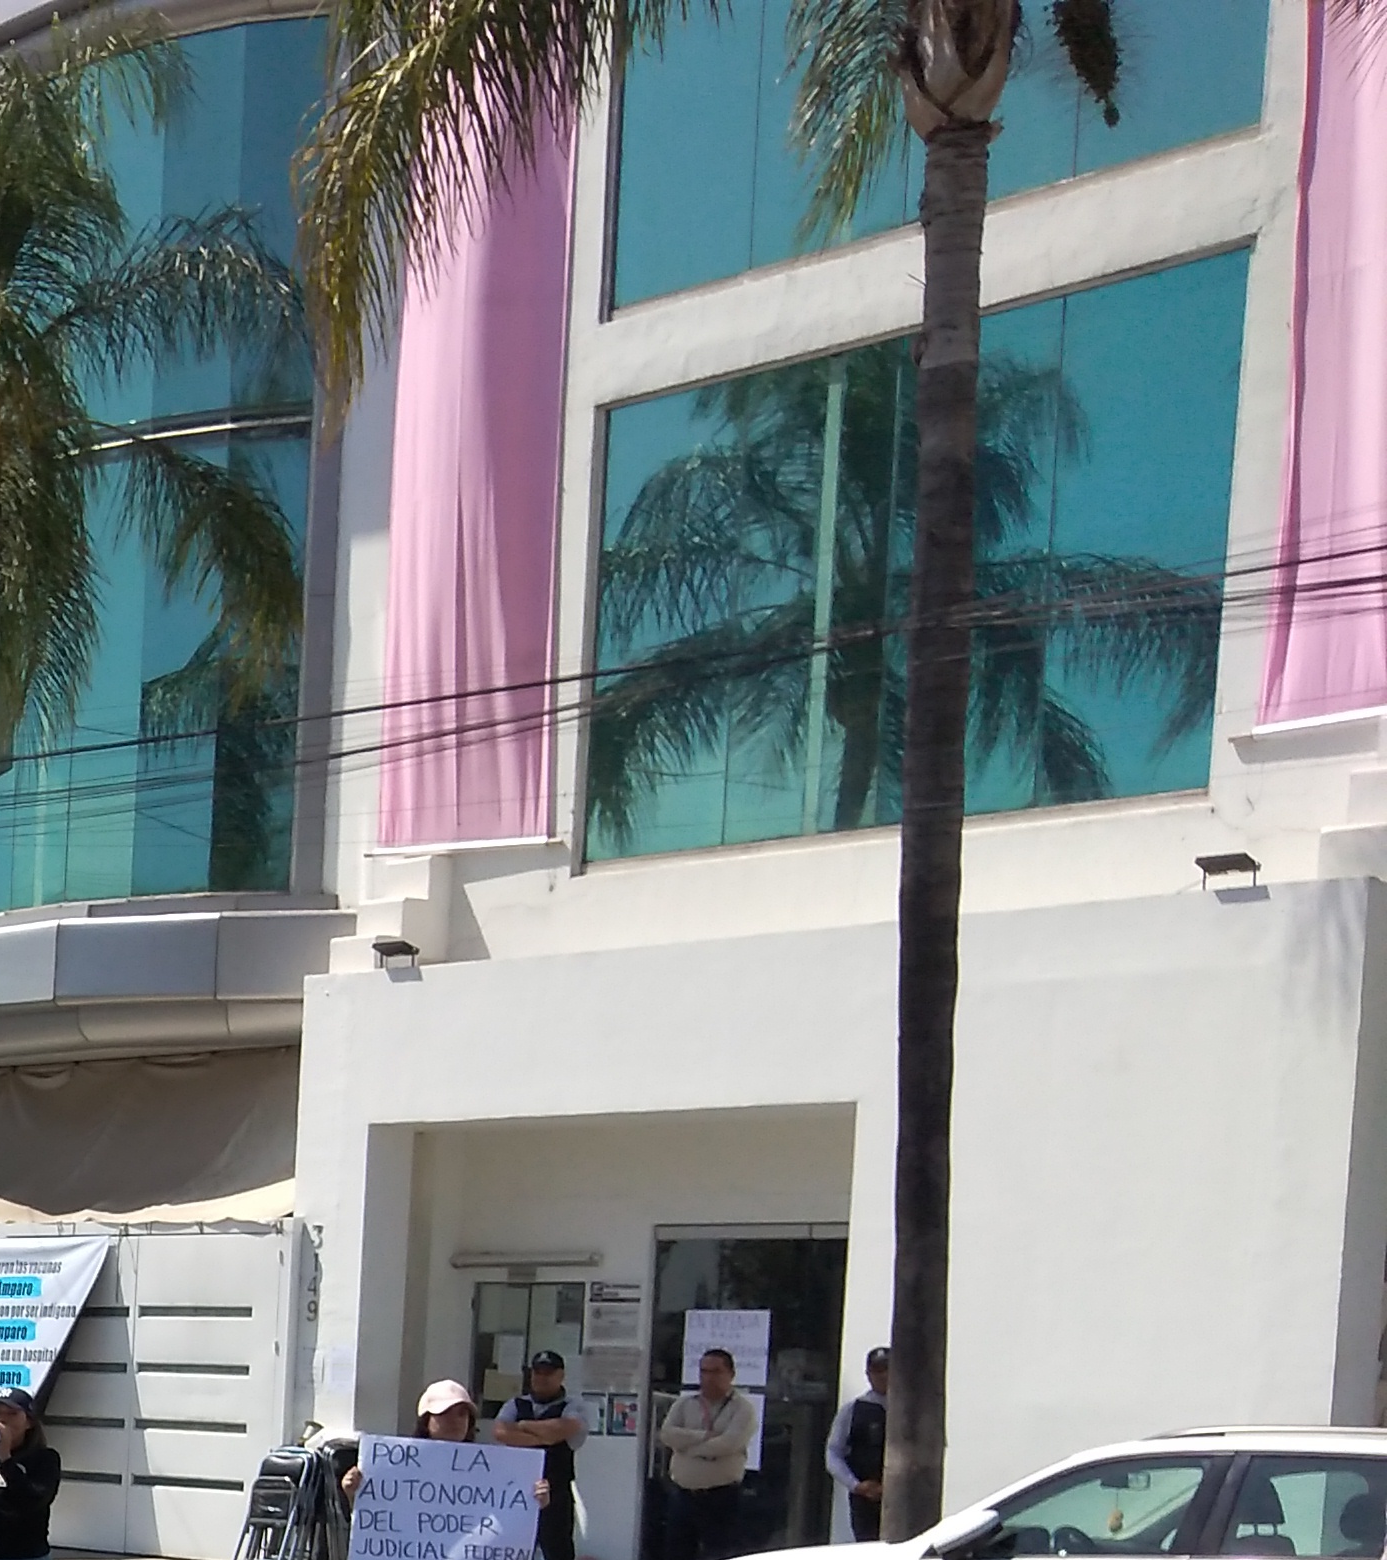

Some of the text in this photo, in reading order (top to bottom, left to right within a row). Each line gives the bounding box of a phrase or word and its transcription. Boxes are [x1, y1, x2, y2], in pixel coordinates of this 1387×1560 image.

[372, 1443, 490, 1472] POR LA
[358, 1478, 528, 1511] AUTONOMÍA
[359, 1509, 499, 1536] DEL PODER
[356, 1538, 456, 1560] JUDICIAL
